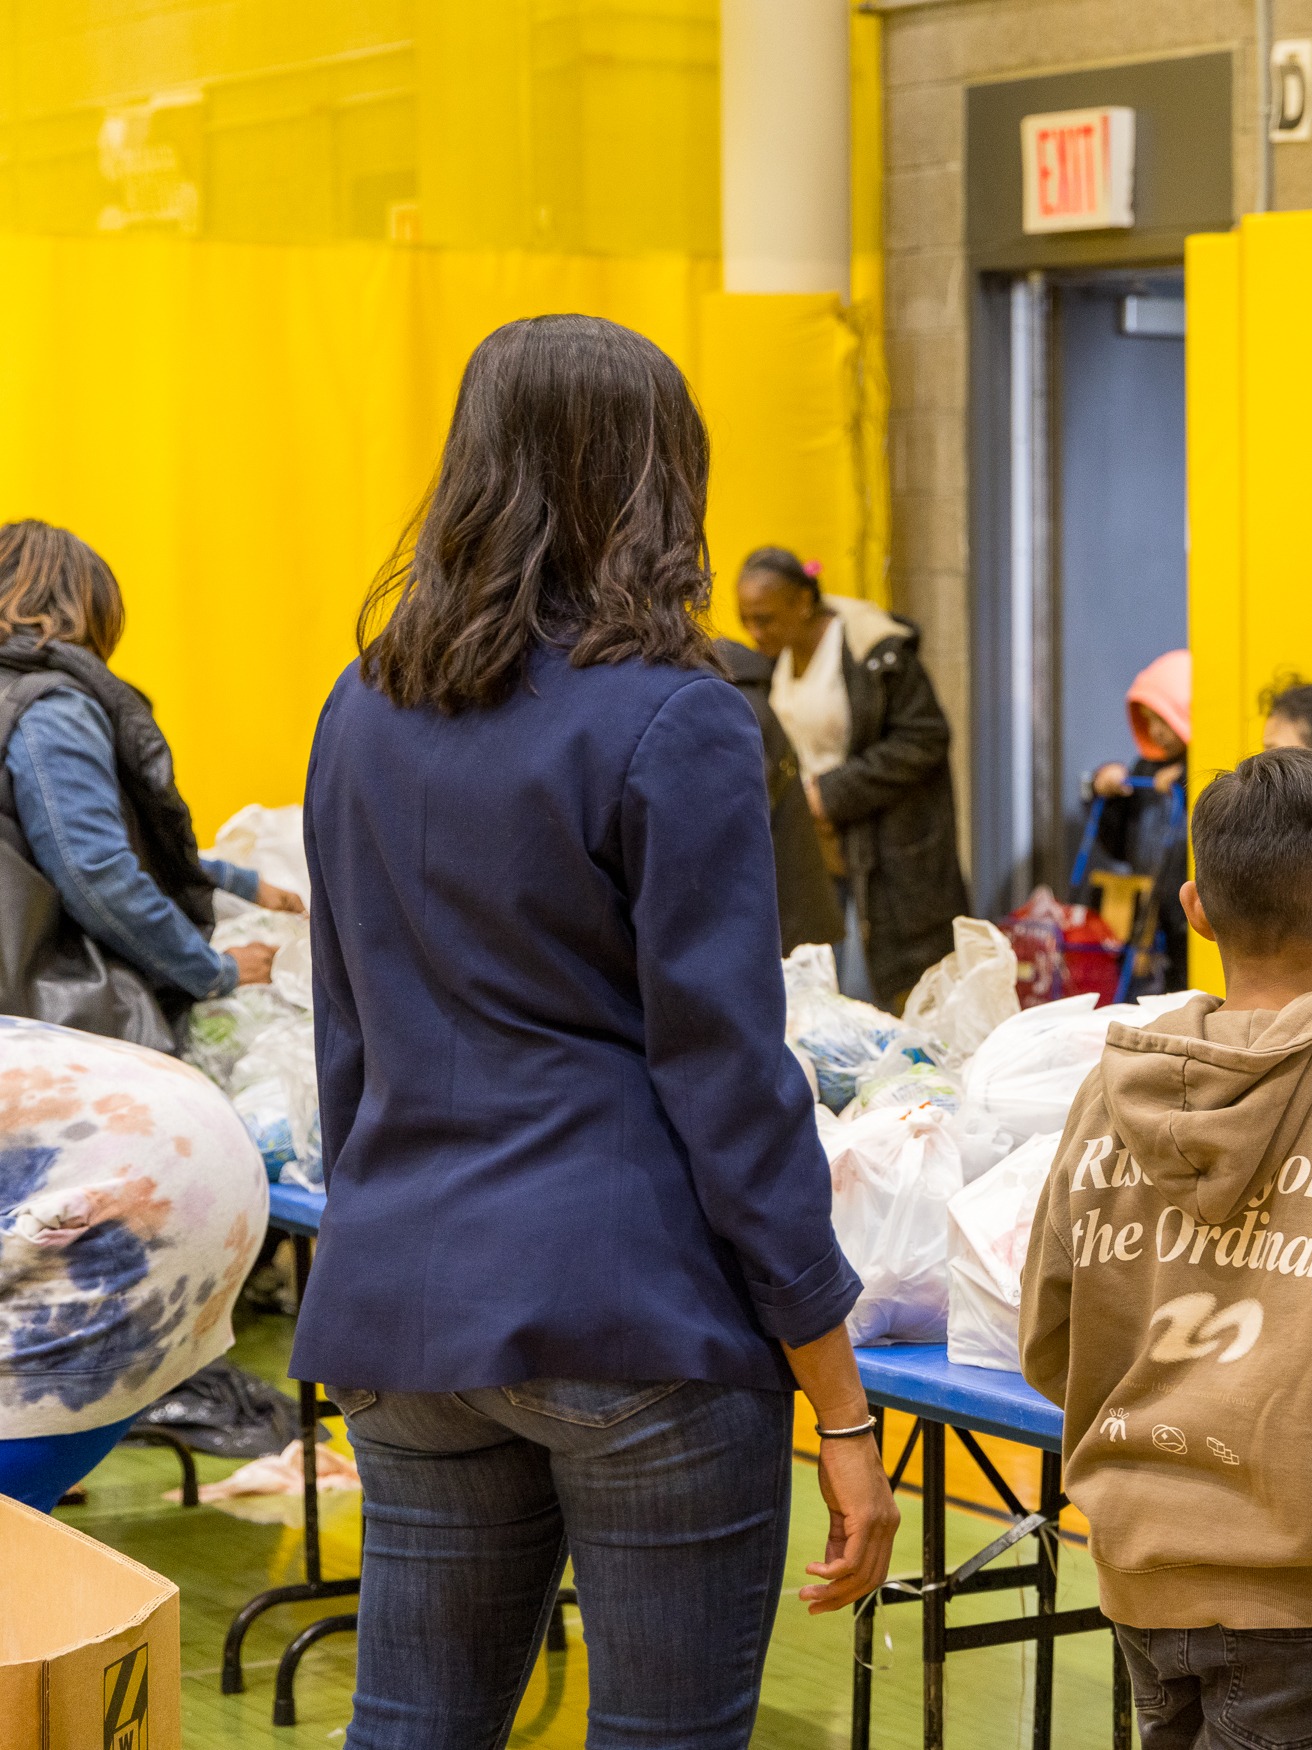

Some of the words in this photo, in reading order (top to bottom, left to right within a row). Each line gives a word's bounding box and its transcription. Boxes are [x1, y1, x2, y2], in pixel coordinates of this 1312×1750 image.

[1036, 124, 1096, 218] EXIT
[1070, 1135, 1154, 1193] Ris
[1072, 1208, 1143, 1268] the
